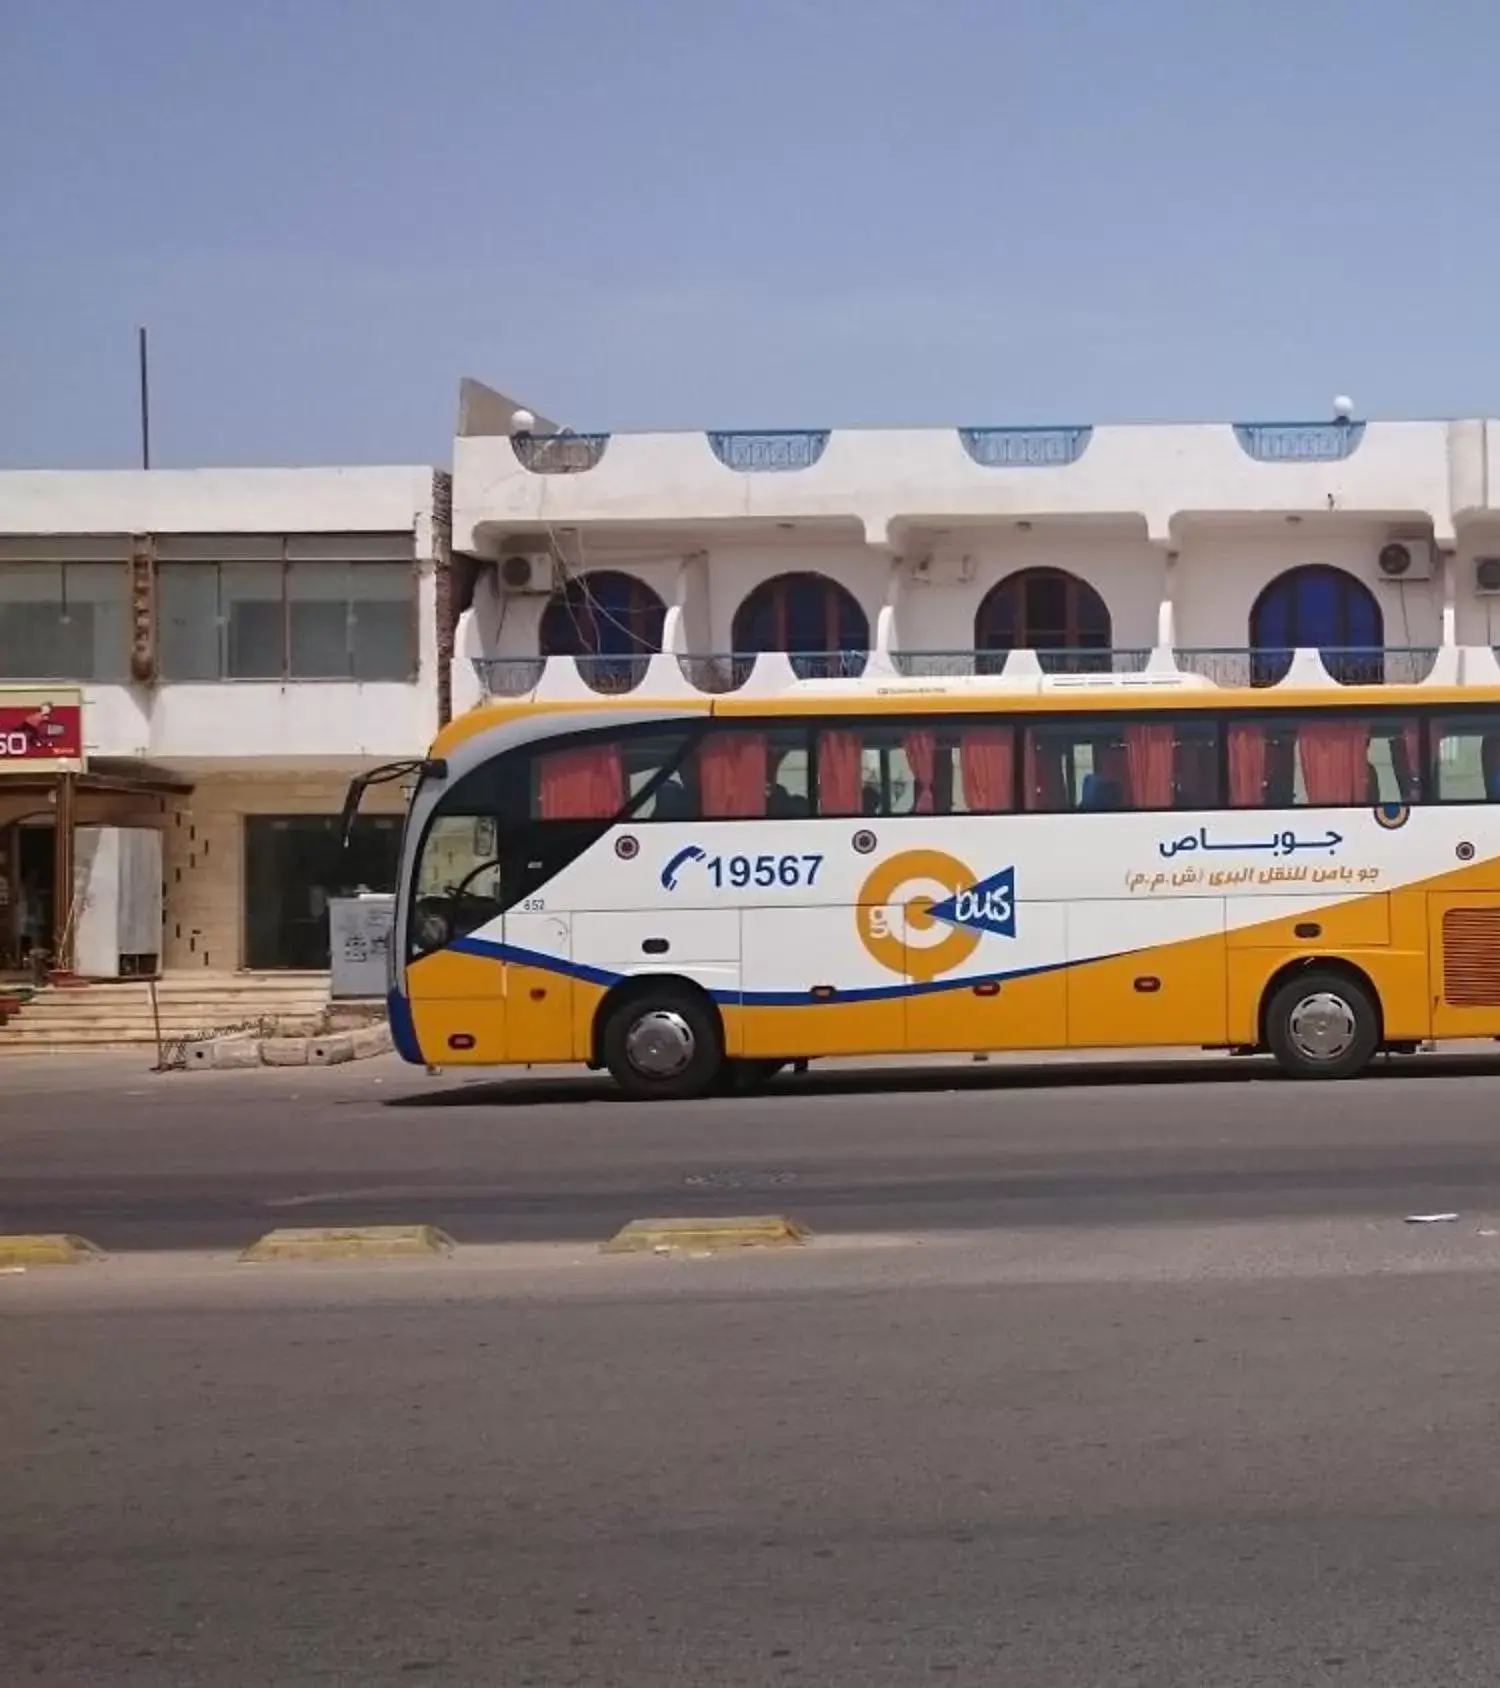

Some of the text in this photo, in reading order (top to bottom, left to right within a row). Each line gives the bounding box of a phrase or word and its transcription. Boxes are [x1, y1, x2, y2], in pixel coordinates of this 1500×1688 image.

[1158, 827, 1344, 858] جوباص
[707, 855, 824, 888] 19567
[1258, 865, 1308, 885] للنقل
[1357, 866, 1380, 884] جو
[954, 883, 1011, 922] bus
